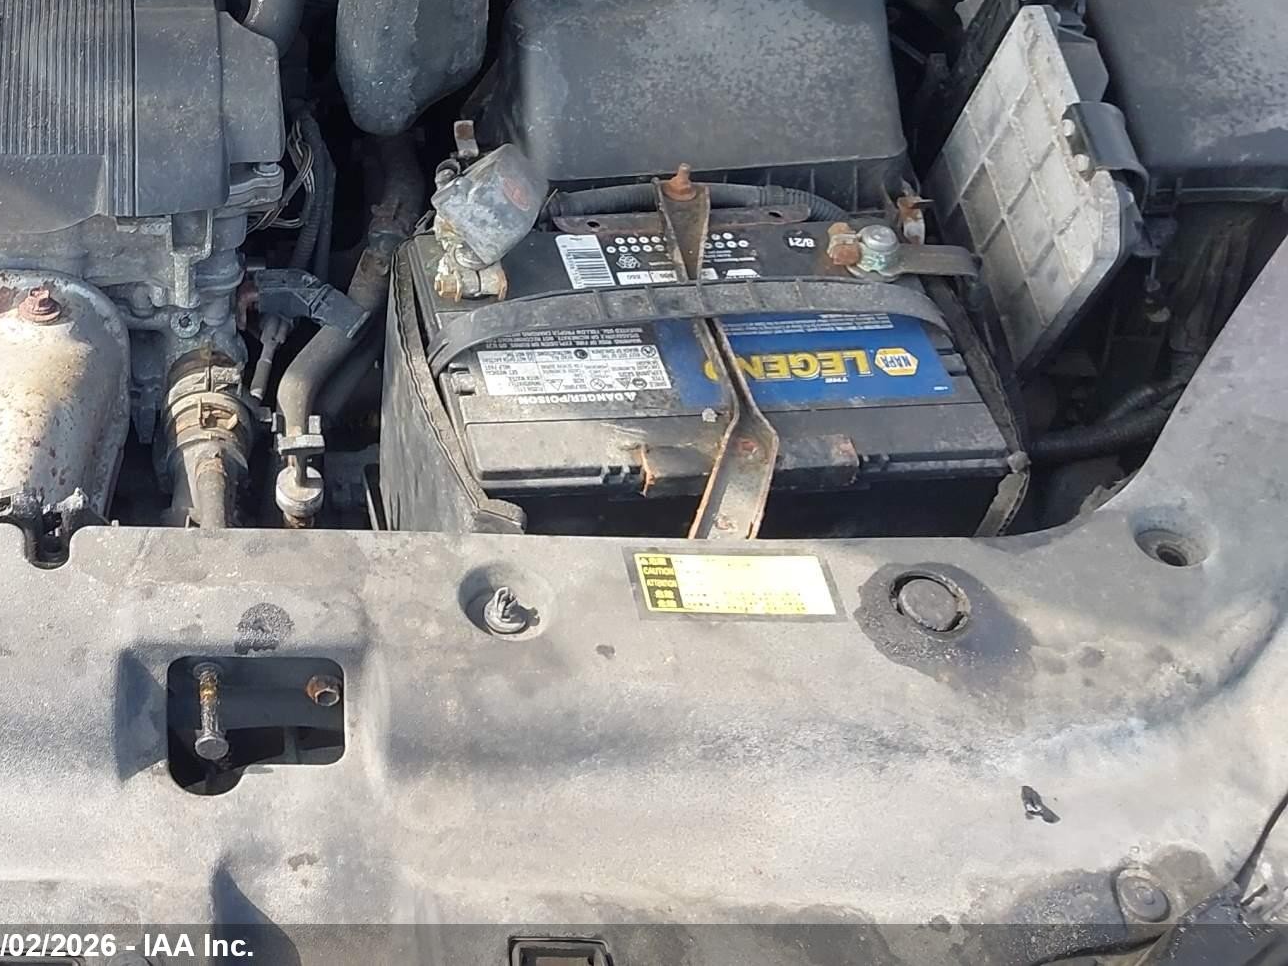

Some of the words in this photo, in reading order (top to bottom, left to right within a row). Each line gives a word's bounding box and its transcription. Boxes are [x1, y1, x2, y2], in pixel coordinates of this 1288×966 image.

[788, 237, 816, 248] 8/21
[880, 355, 911, 368] NAPA
[518, 392, 624, 405] DANGER/POISON
[643, 566, 675, 575] CAUTION
